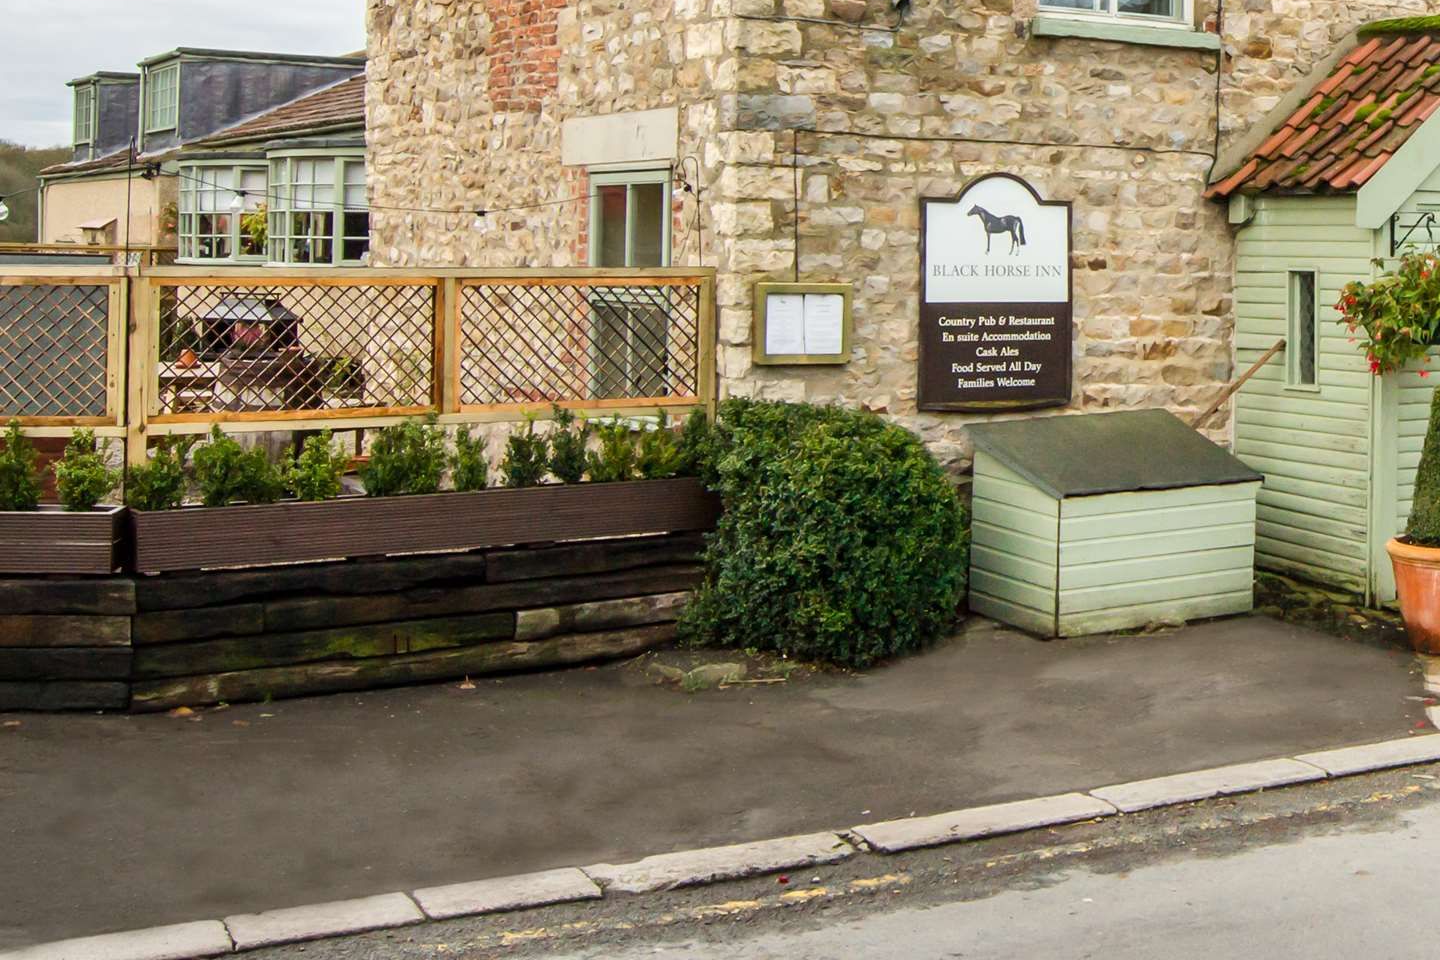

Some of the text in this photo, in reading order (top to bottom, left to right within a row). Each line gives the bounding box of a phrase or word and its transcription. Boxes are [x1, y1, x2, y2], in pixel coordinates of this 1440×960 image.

[932, 264, 1062, 277] BLACK HORSE INN
[938, 316, 1055, 328] Country Pub & Restaurant
[942, 331, 1051, 342] En suite Accommodation
[976, 346, 1019, 357] Cask Ales
[951, 361, 1041, 373] Food Served All Day
[958, 376, 1036, 389] Families Welcome
